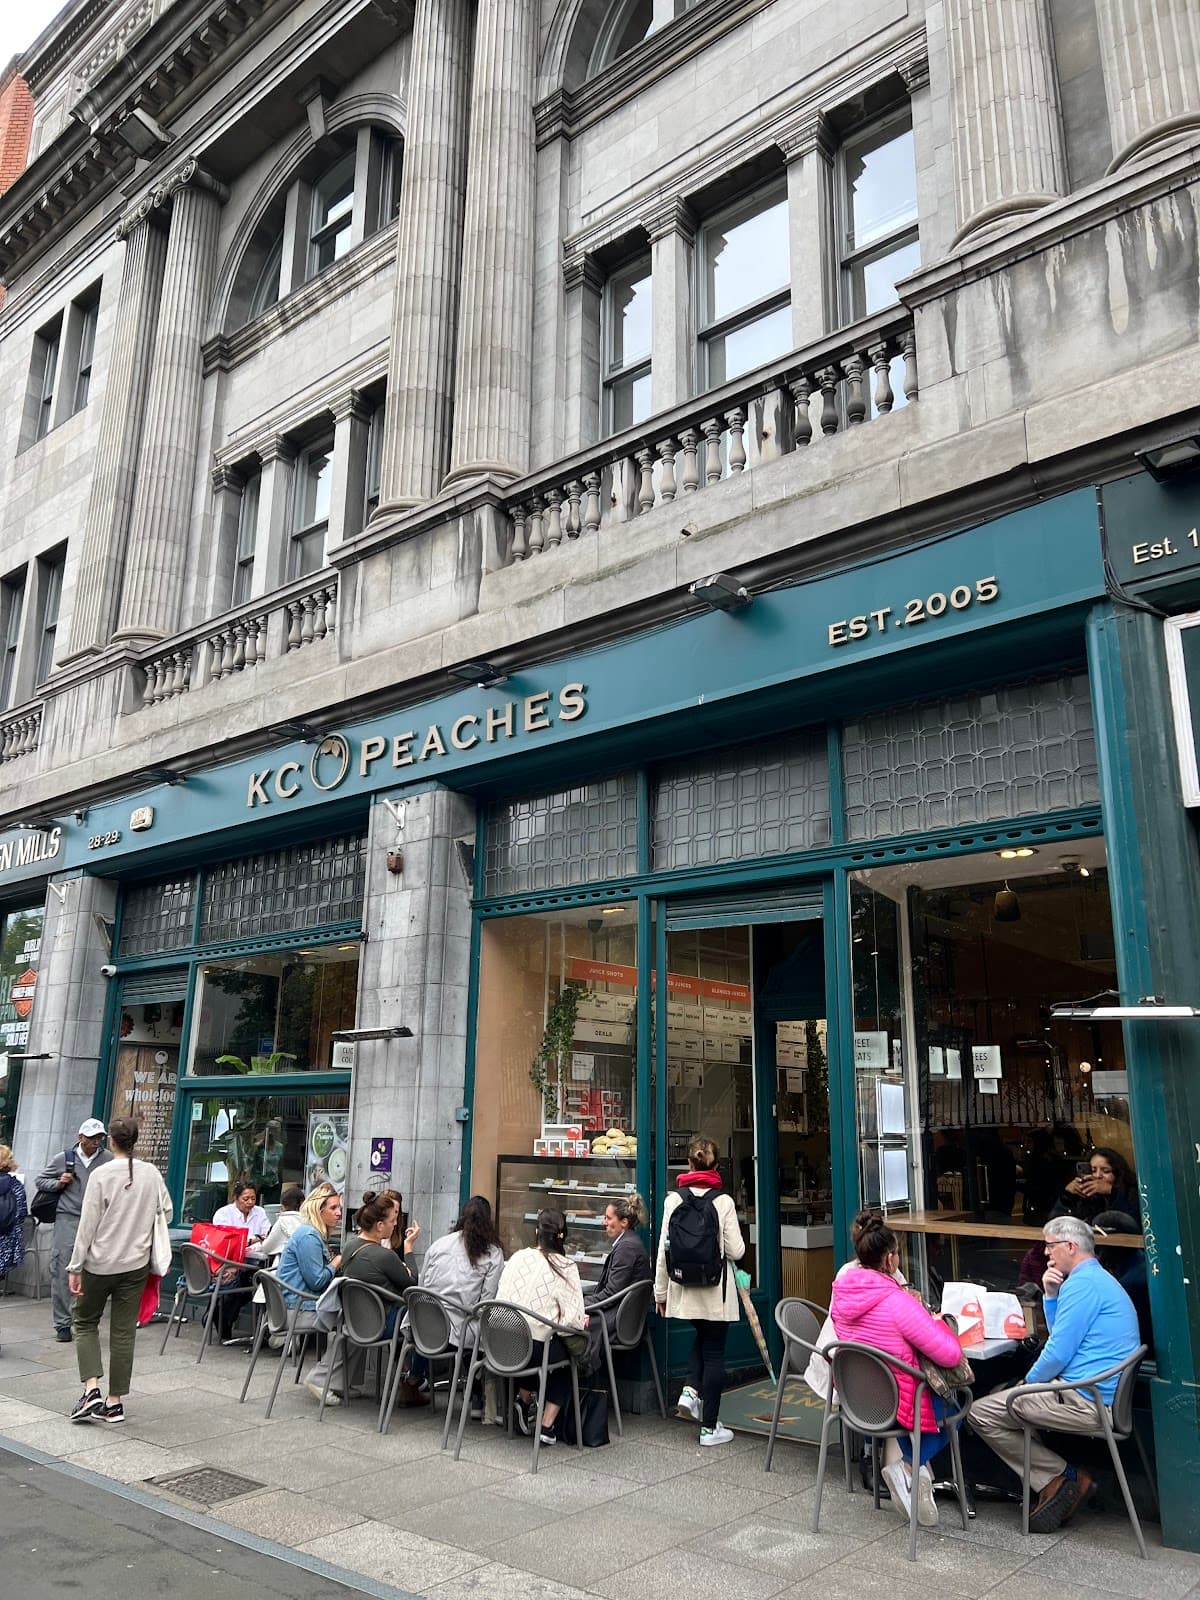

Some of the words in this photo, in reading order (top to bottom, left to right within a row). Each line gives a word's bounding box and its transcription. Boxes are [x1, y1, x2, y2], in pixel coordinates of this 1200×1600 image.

[1132, 537, 1179, 564] Est.
[828, 576, 999, 647] EST.2005
[246, 761, 302, 808] KC
[359, 682, 590, 777] PEACHES
[15, 826, 62, 867] MILLS
[87, 830, 119, 849] 28-29
[134, 1071, 155, 1083] WE
